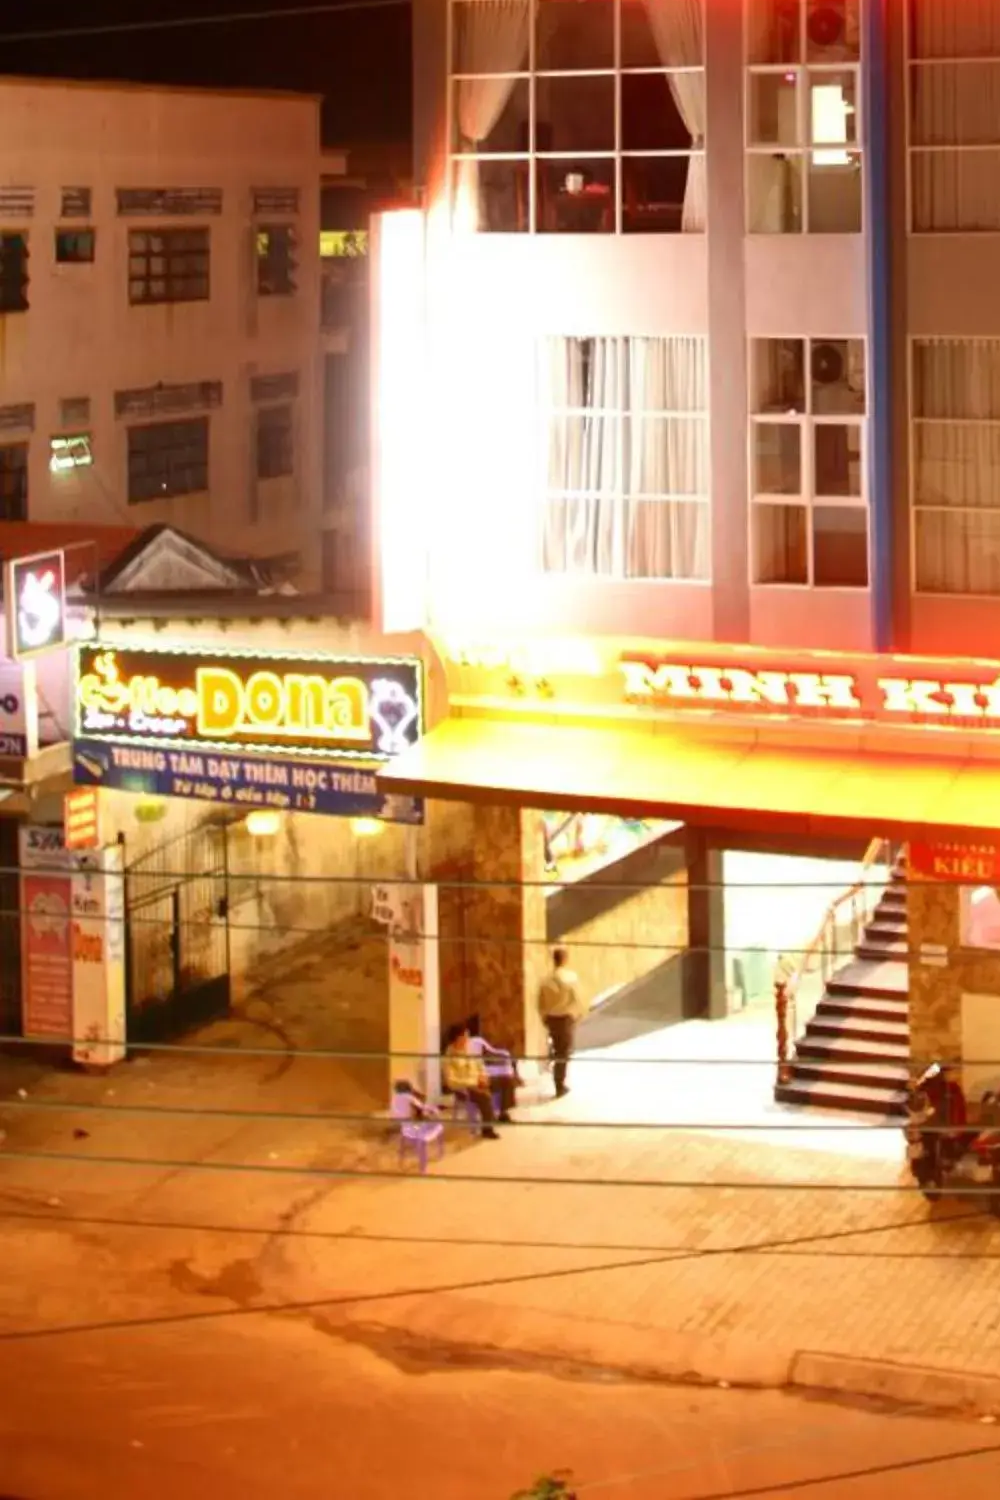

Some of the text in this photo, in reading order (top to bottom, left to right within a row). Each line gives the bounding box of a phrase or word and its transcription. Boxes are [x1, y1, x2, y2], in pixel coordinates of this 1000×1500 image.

[196, 667, 370, 740] Dona
[619, 660, 861, 708] MINH
[111, 746, 167, 772] TRUNG
[291, 767, 328, 791] HỌC
